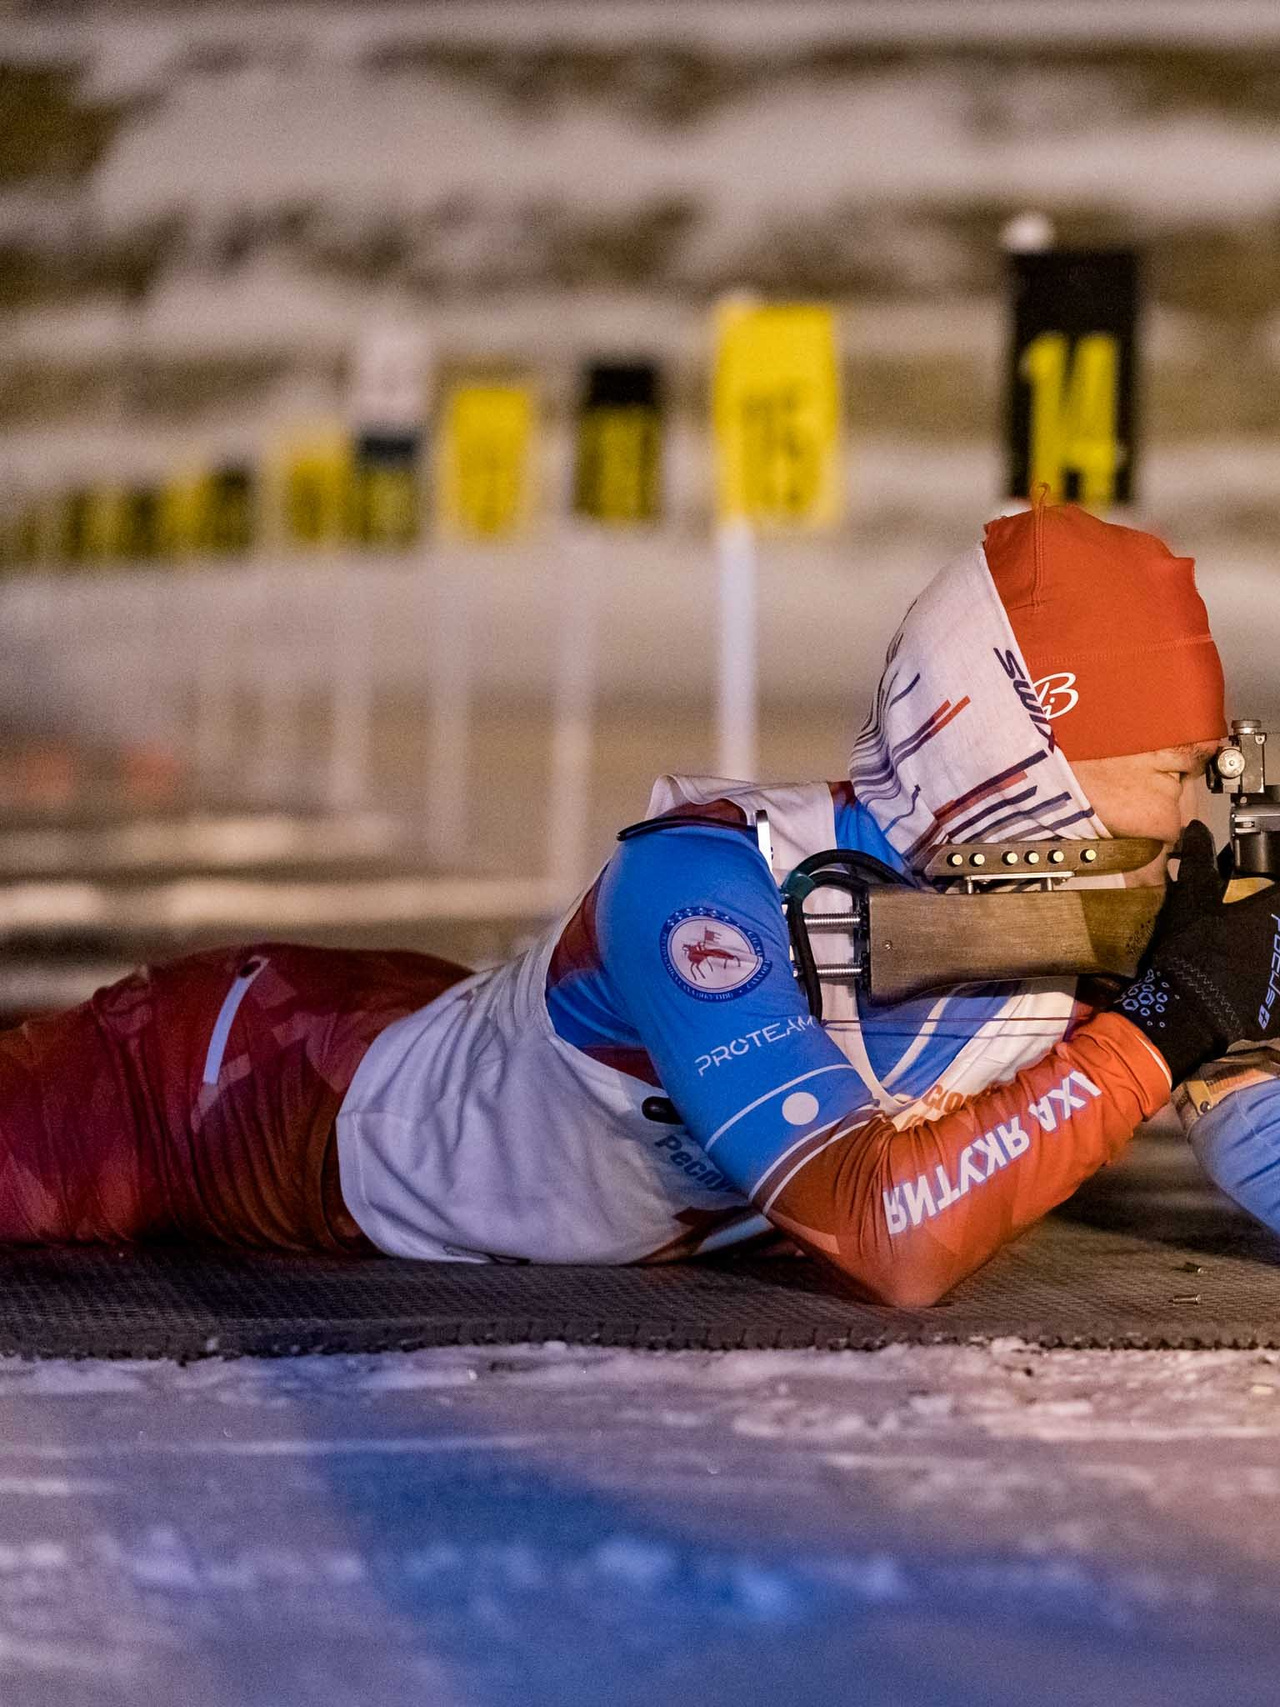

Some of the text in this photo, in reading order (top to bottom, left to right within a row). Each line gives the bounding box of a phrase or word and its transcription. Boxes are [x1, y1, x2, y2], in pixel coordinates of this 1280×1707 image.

[1025, 333, 1123, 505] 14
[695, 1014, 817, 1076] PROTEAM
[882, 1116, 1030, 1235] ЯКУТИЯ
